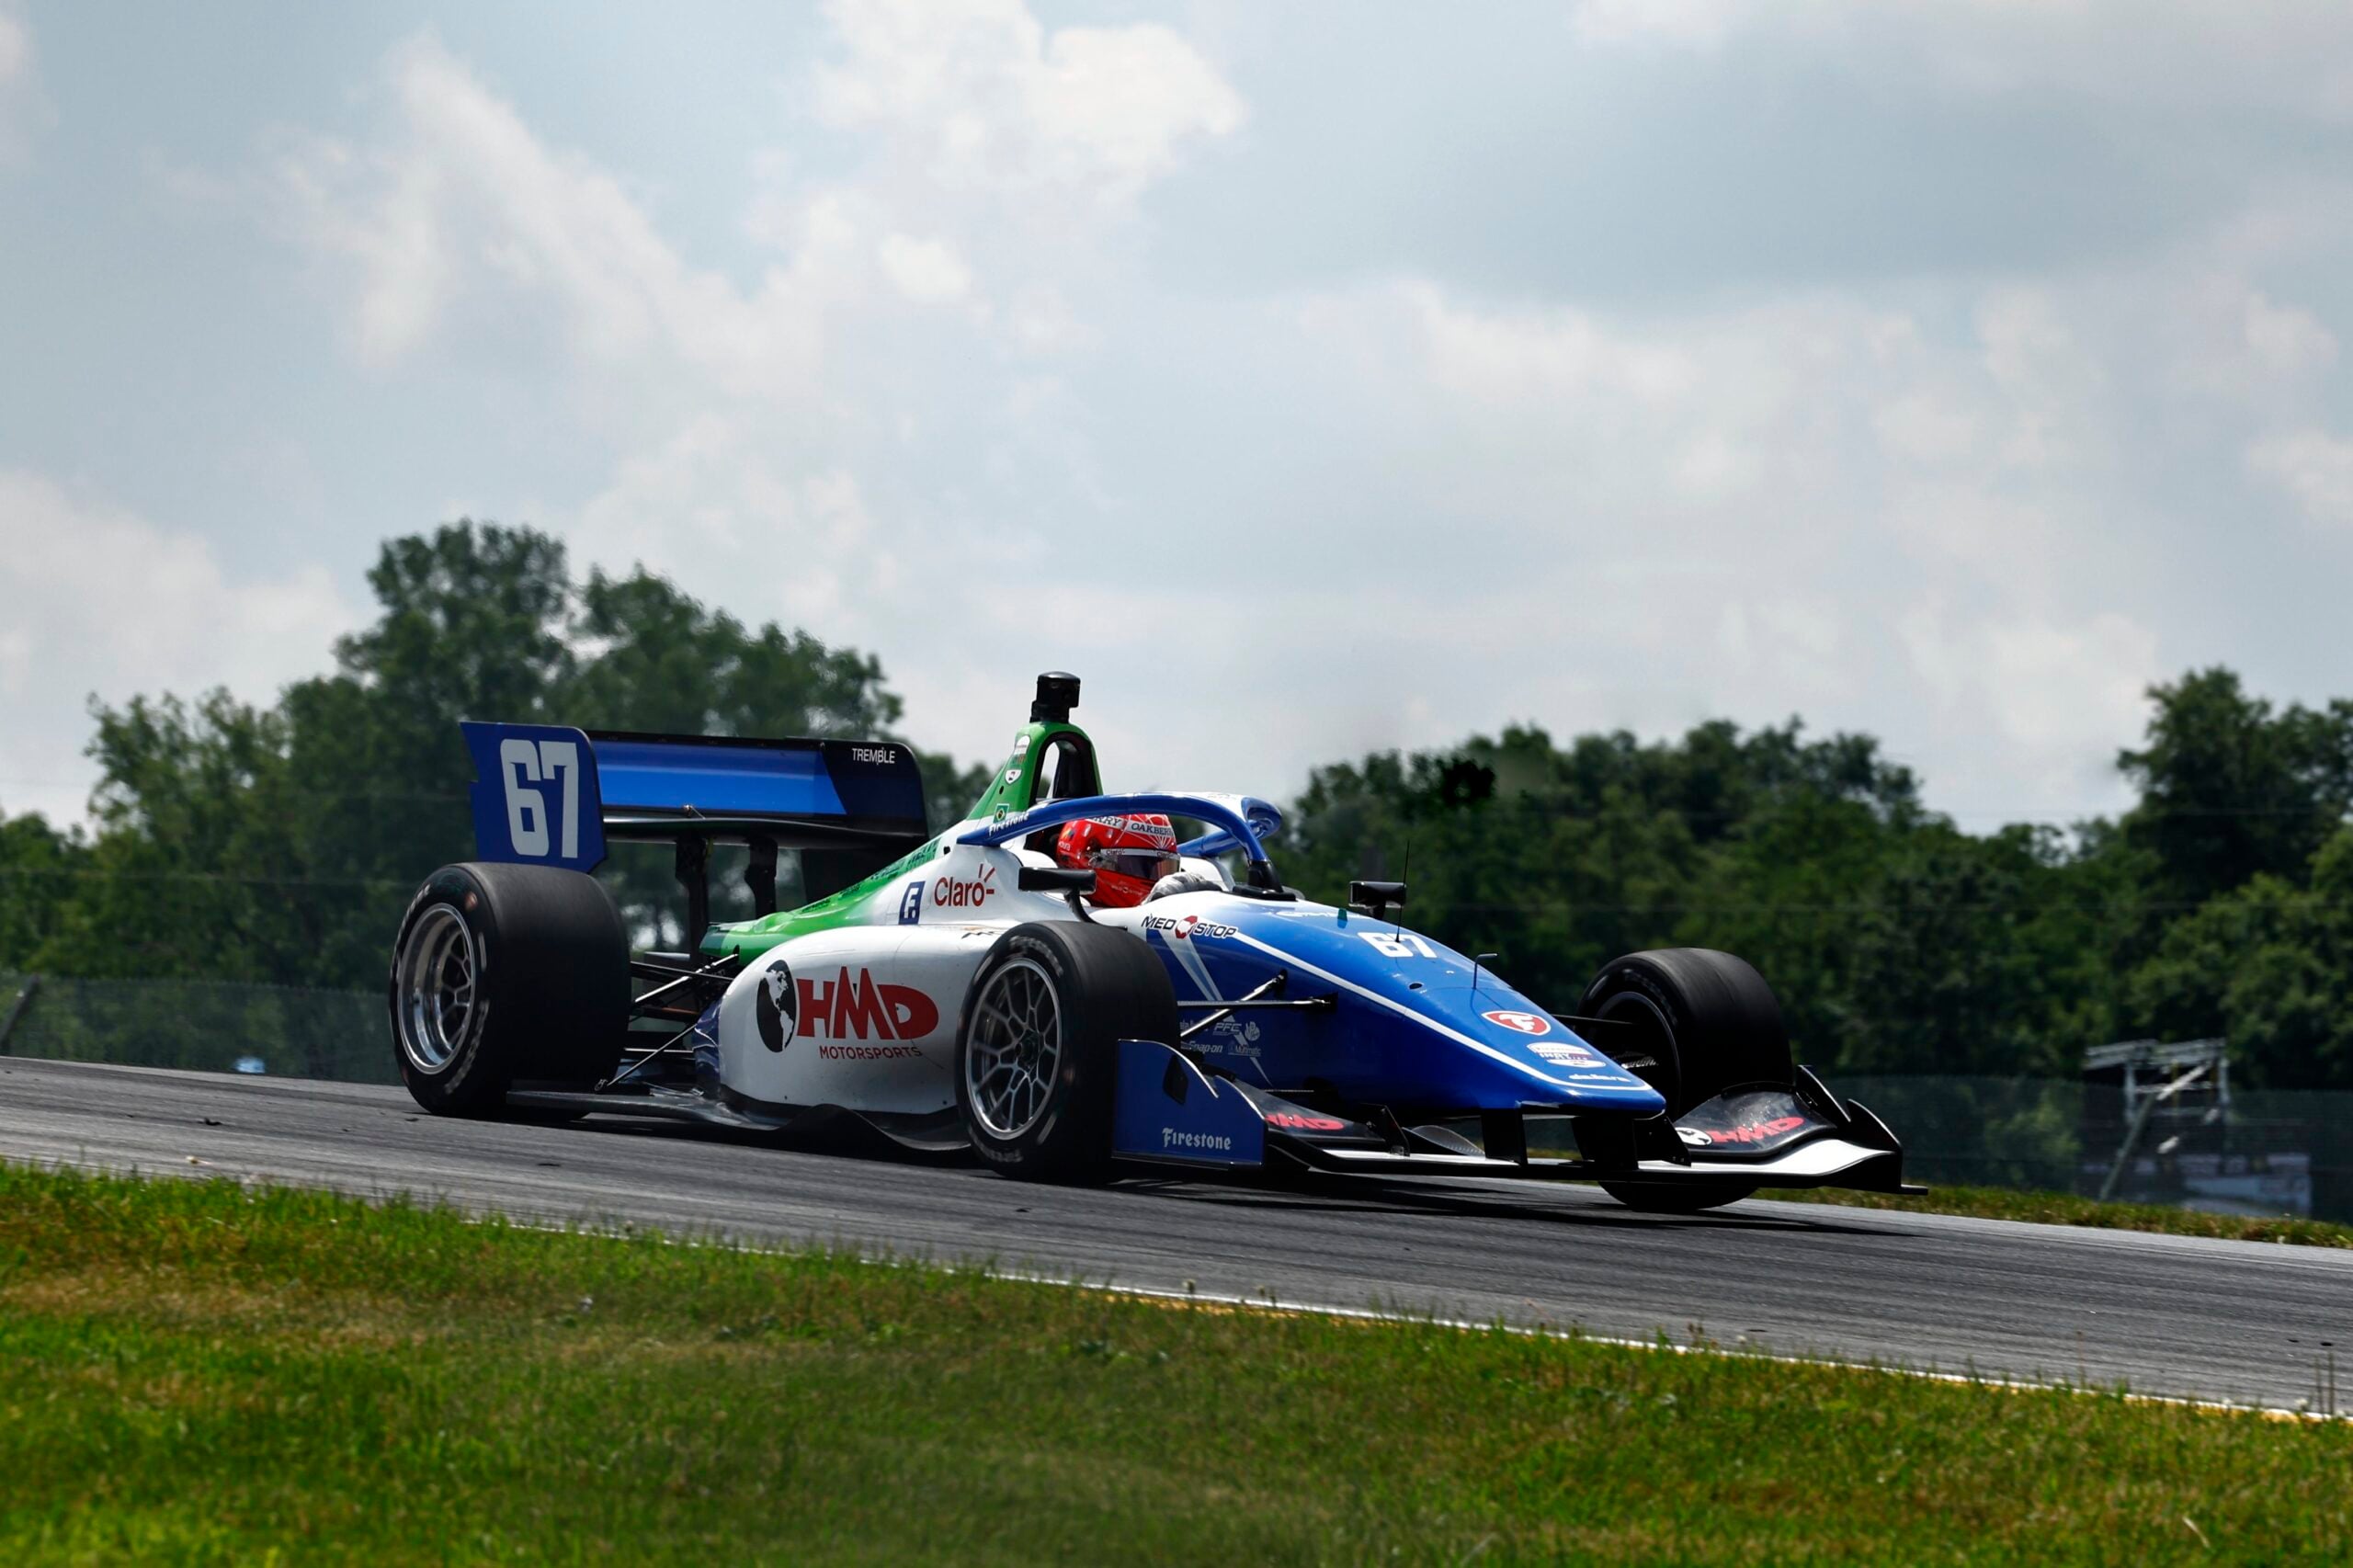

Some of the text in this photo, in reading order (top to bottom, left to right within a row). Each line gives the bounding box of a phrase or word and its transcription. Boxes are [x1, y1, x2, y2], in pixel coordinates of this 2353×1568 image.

[852, 747, 896, 765] TREMBLE
[500, 738, 579, 858] 67
[989, 811, 1029, 836] Firestone
[1141, 916, 1237, 938] MED STOP
[1358, 932, 1438, 959] 67
[796, 966, 939, 1040] HMD
[819, 1045, 924, 1061] MOTORSPORTS
[1162, 1127, 1232, 1150] Firestone
[1706, 1116, 1805, 1143] HMD
